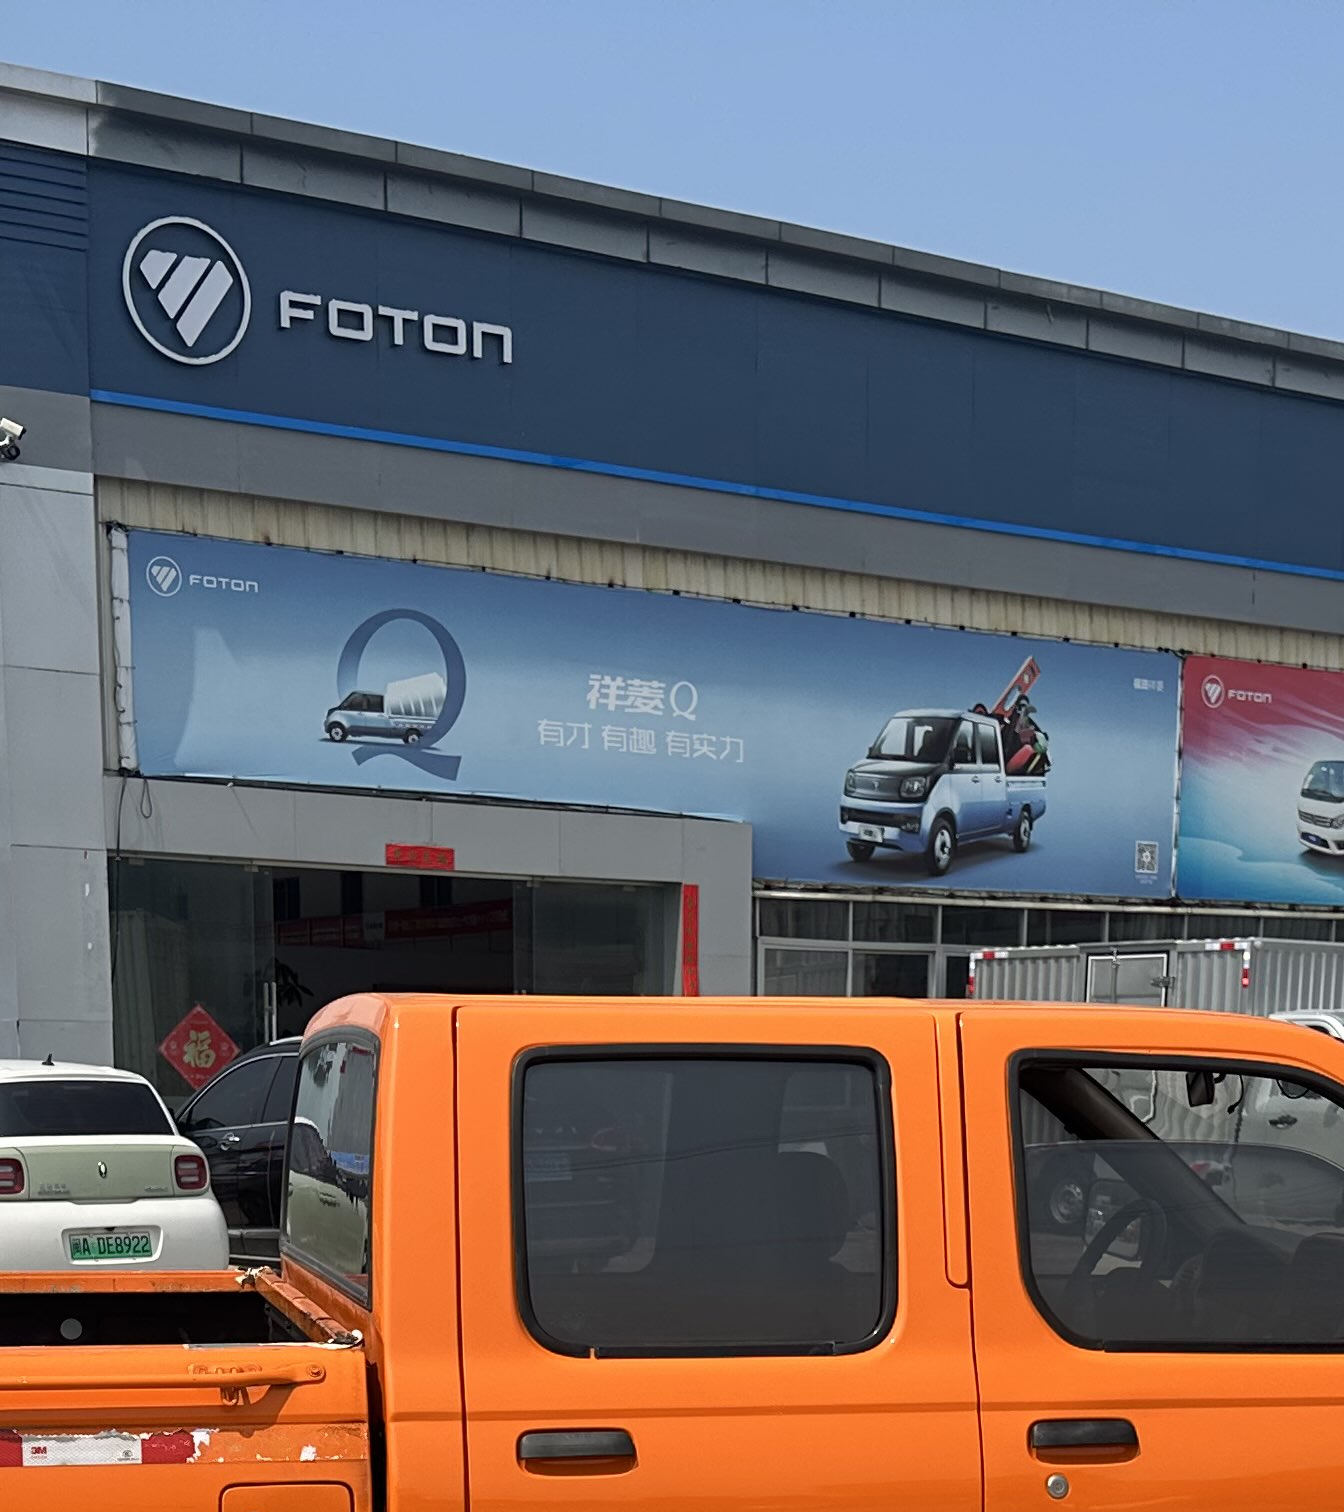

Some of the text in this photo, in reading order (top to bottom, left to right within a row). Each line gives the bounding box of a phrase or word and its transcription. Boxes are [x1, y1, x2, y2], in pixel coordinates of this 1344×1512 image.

[280, 290, 512, 364] FOTON
[189, 574, 258, 593] FOTON
[1228, 689, 1272, 704] FOTON
[183, 1030, 216, 1068] 福
